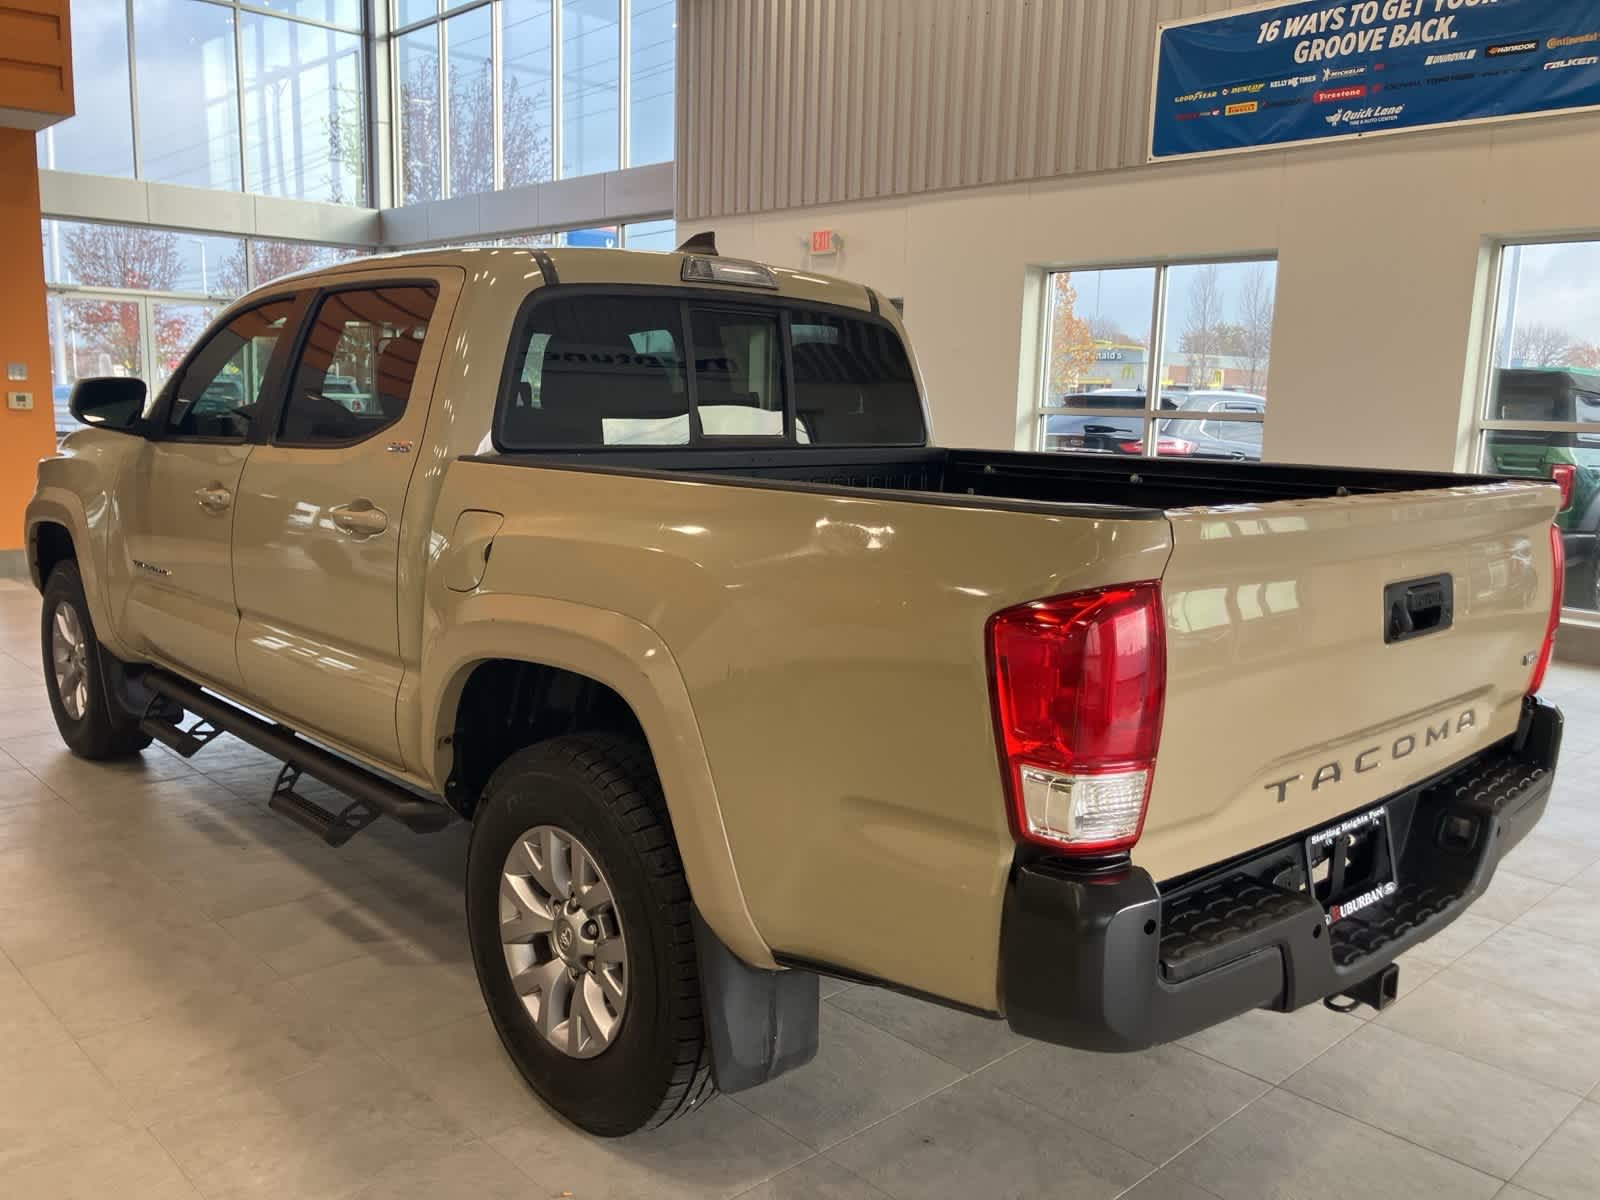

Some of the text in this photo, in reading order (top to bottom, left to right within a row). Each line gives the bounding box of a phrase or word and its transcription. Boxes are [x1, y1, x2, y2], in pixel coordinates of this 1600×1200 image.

[1257, 20, 1281, 44] 16
[1283, 7, 1345, 38] WAYS
[1350, 1, 1378, 27] TO
[1382, 0, 1423, 20] GET
[1294, 15, 1458, 64] GROOVE BACK.
[1329, 66, 1366, 77] MICHELIN
[1270, 75, 1316, 88] KELLY TIRES
[1231, 83, 1265, 94] DUNLOP
[1174, 91, 1217, 103] GOODYEAR
[1319, 89, 1361, 102] Firestone
[1342, 102, 1403, 121] Quick Lane
[1264, 709, 1476, 803] TACOMA
[1369, 807, 1385, 819] Ford
